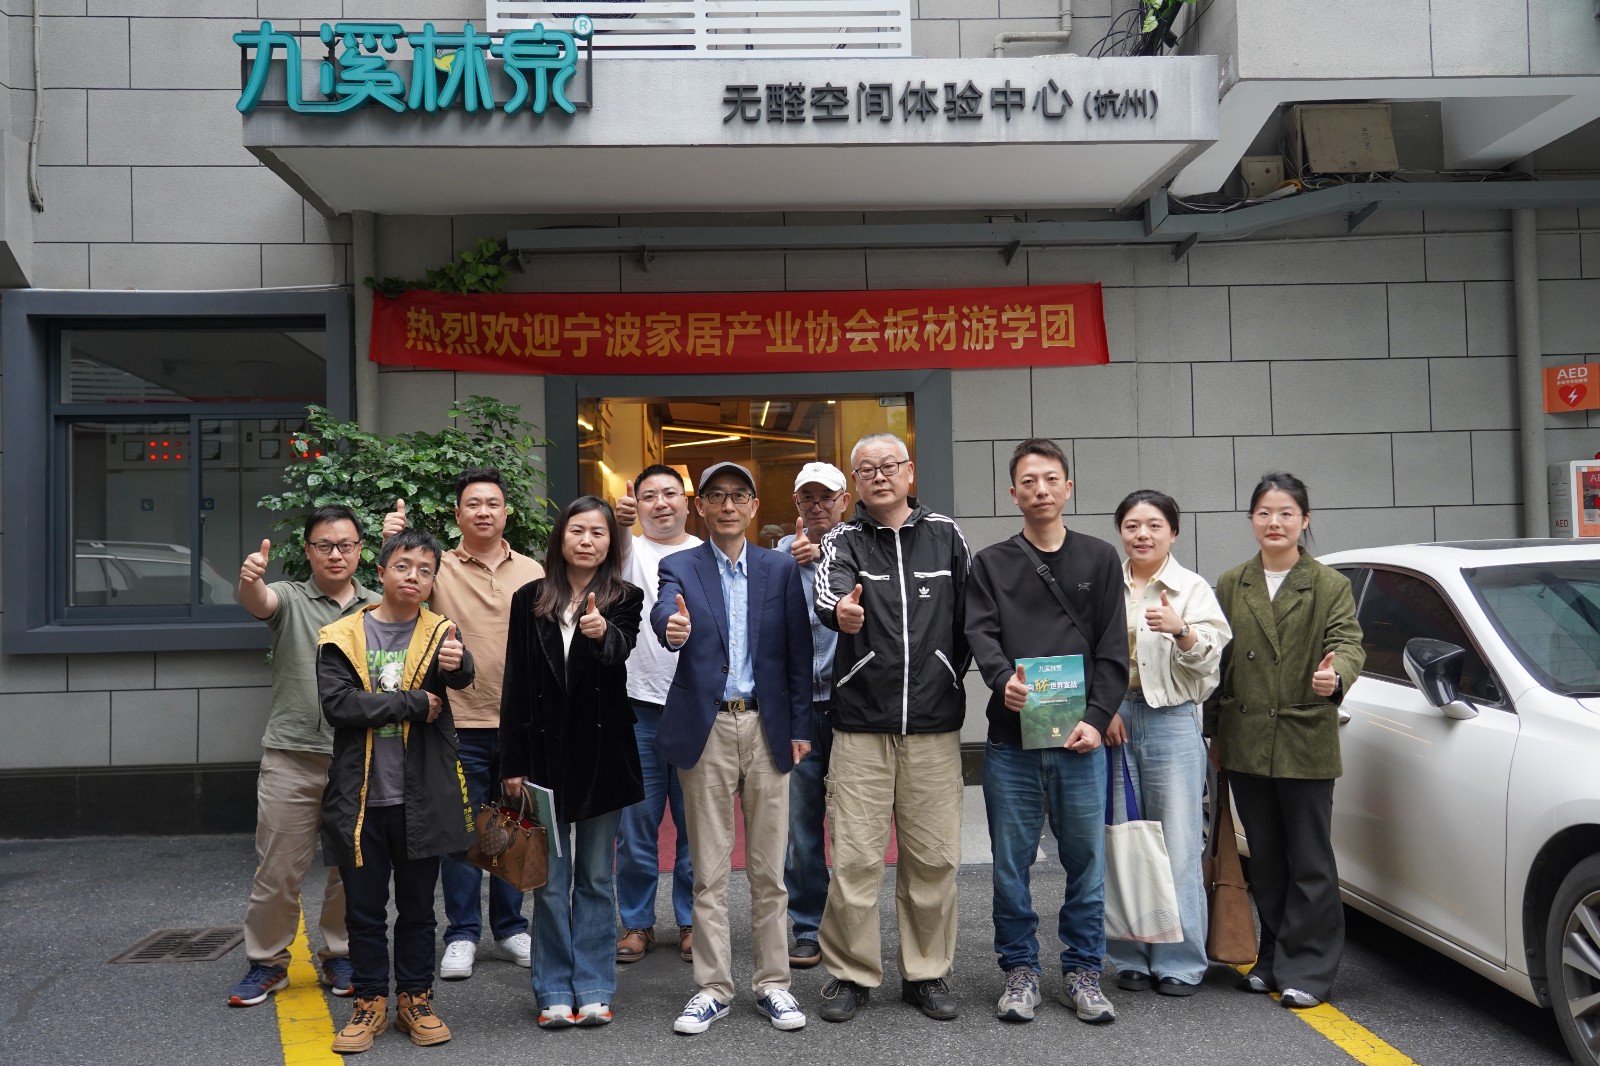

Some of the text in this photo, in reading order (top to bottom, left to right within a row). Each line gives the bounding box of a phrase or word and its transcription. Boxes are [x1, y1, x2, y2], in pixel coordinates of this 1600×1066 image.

[232, 19, 578, 115] 九溪林泉
[405, 303, 1076, 358] 热烈欢迎宁波家居产业协会板材游学团
[1557, 367, 1588, 380] AED
[1555, 519, 1569, 528] AED
